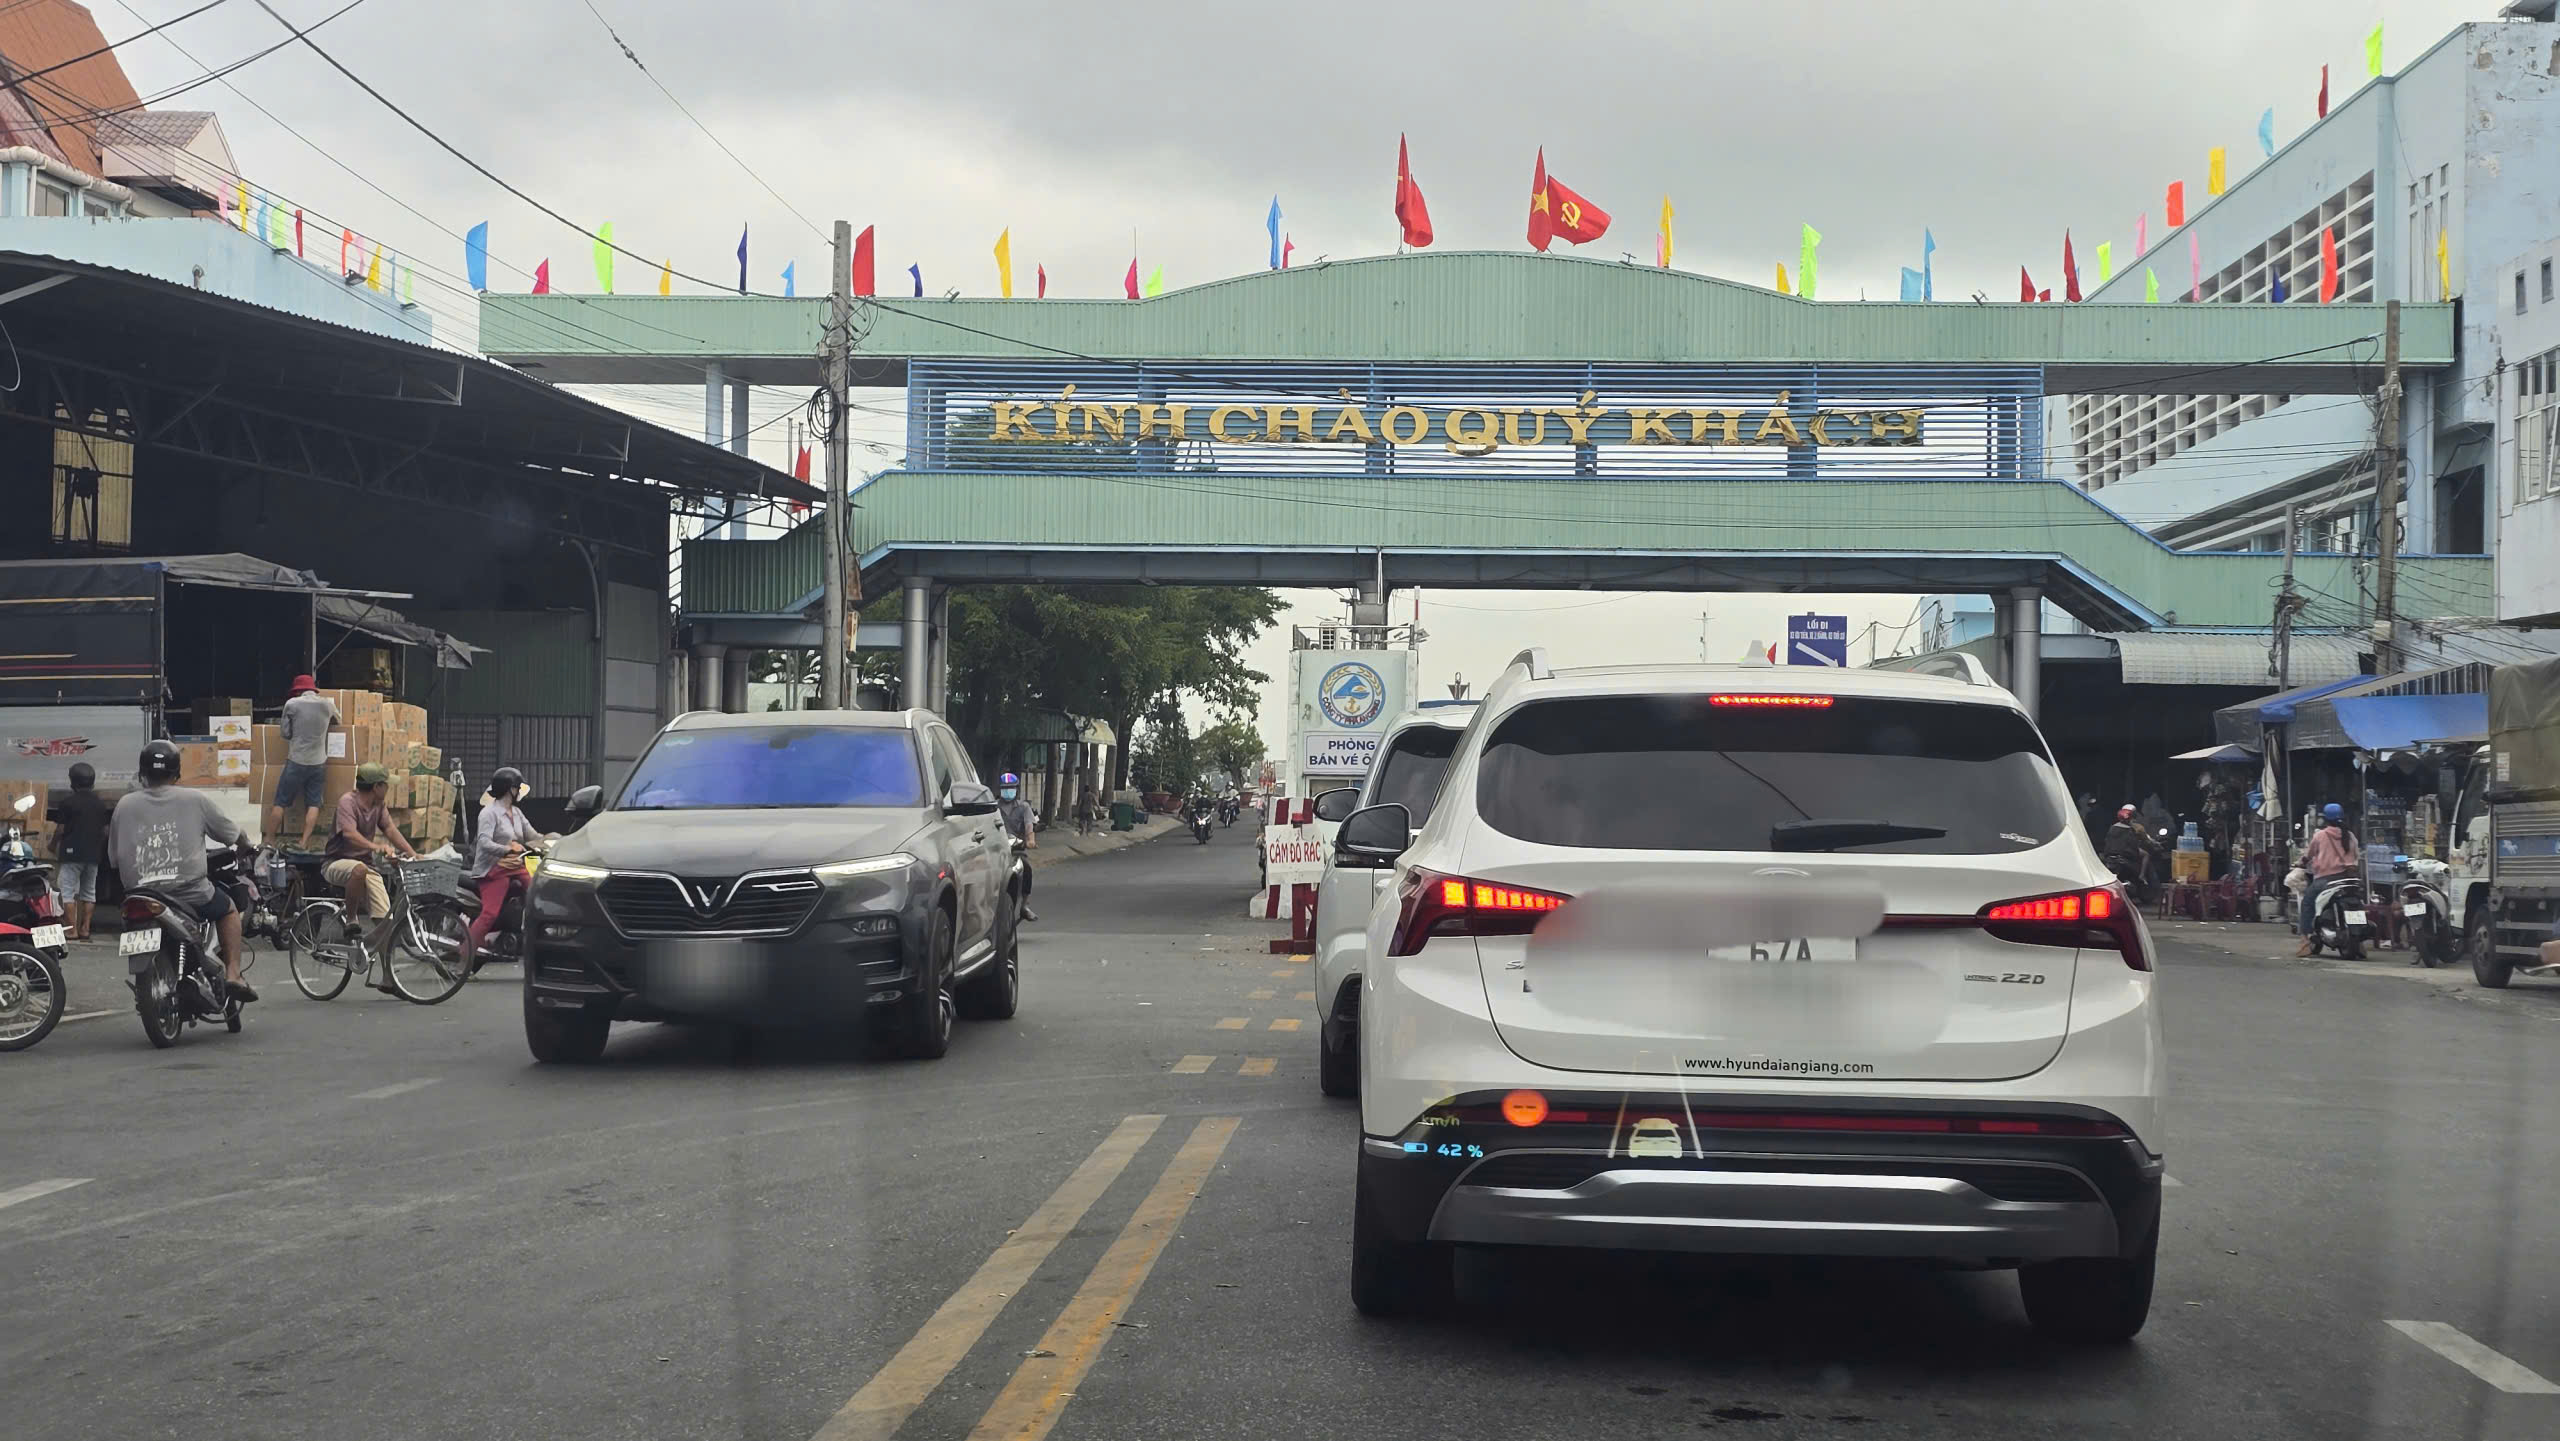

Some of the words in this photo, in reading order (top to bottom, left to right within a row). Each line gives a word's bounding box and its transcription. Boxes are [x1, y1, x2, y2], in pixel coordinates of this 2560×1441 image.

[988, 384, 1191, 441] KÍNH
[1208, 387, 1430, 445] CHÀO
[1445, 390, 1608, 456] QUÝ
[1625, 390, 1925, 447] KHÁCH
[1328, 738, 1376, 751] PHÒNG
[1309, 753, 1337, 766] BÁN
[1341, 753, 1358, 766] VÉ
[1269, 834, 1289, 864] CẤM
[1303, 834, 1321, 863] RÁC
[1684, 1057, 1874, 1075] www.hyundaiangiang.com
[1422, 1114, 1460, 1127] km/h
[1437, 1143, 1462, 1157] 42
[1467, 1144, 1484, 1158] %
